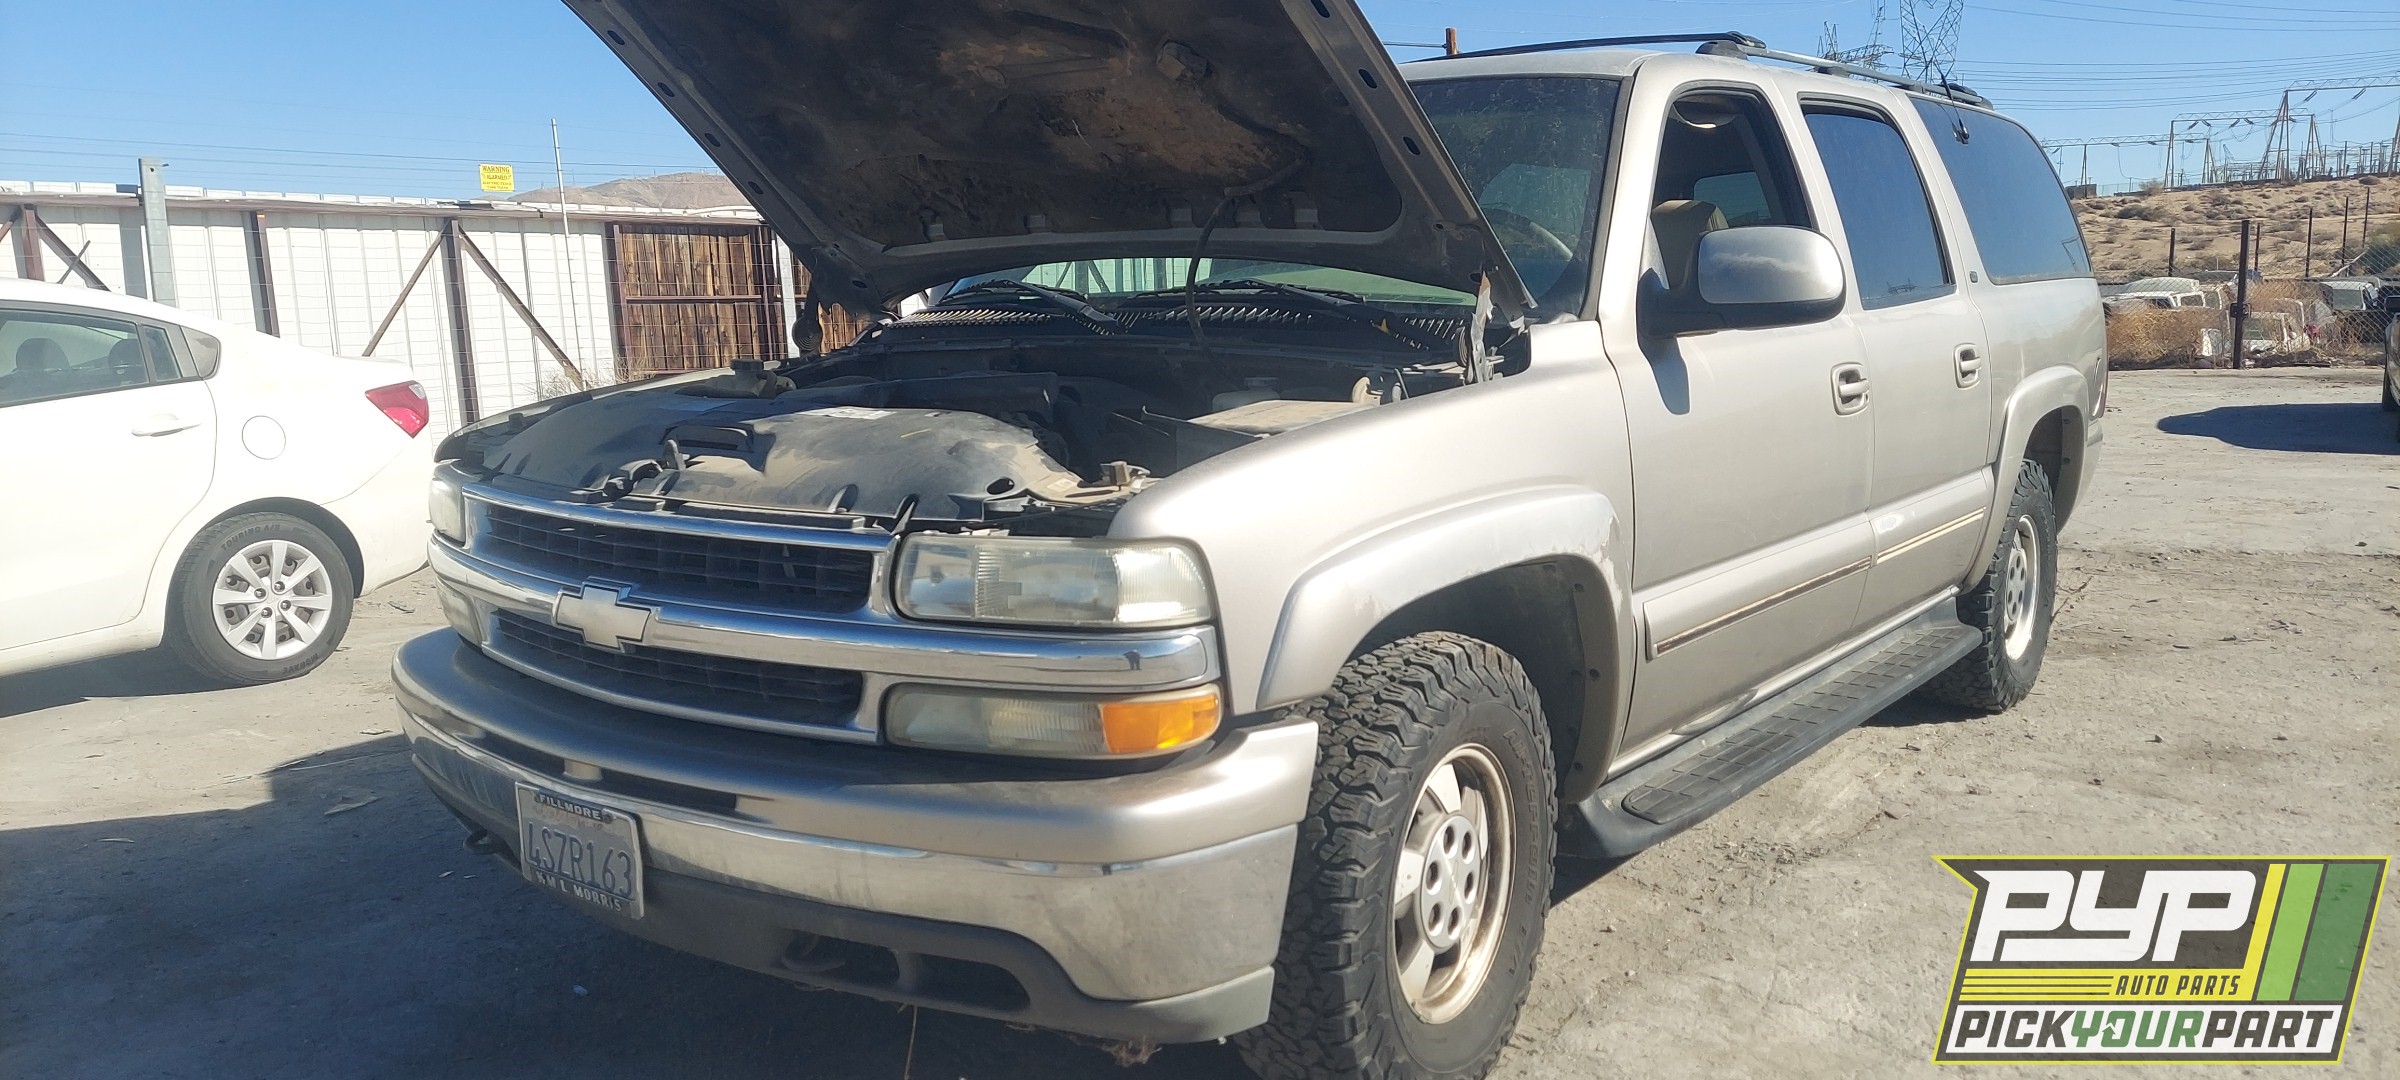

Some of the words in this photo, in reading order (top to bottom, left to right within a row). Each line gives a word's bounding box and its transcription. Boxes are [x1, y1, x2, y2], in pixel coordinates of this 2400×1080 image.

[539, 794, 602, 820] FILLMORE
[528, 822, 632, 898] 4SZR163
[560, 879, 568, 893] L
[573, 885, 623, 912] MORRIS
